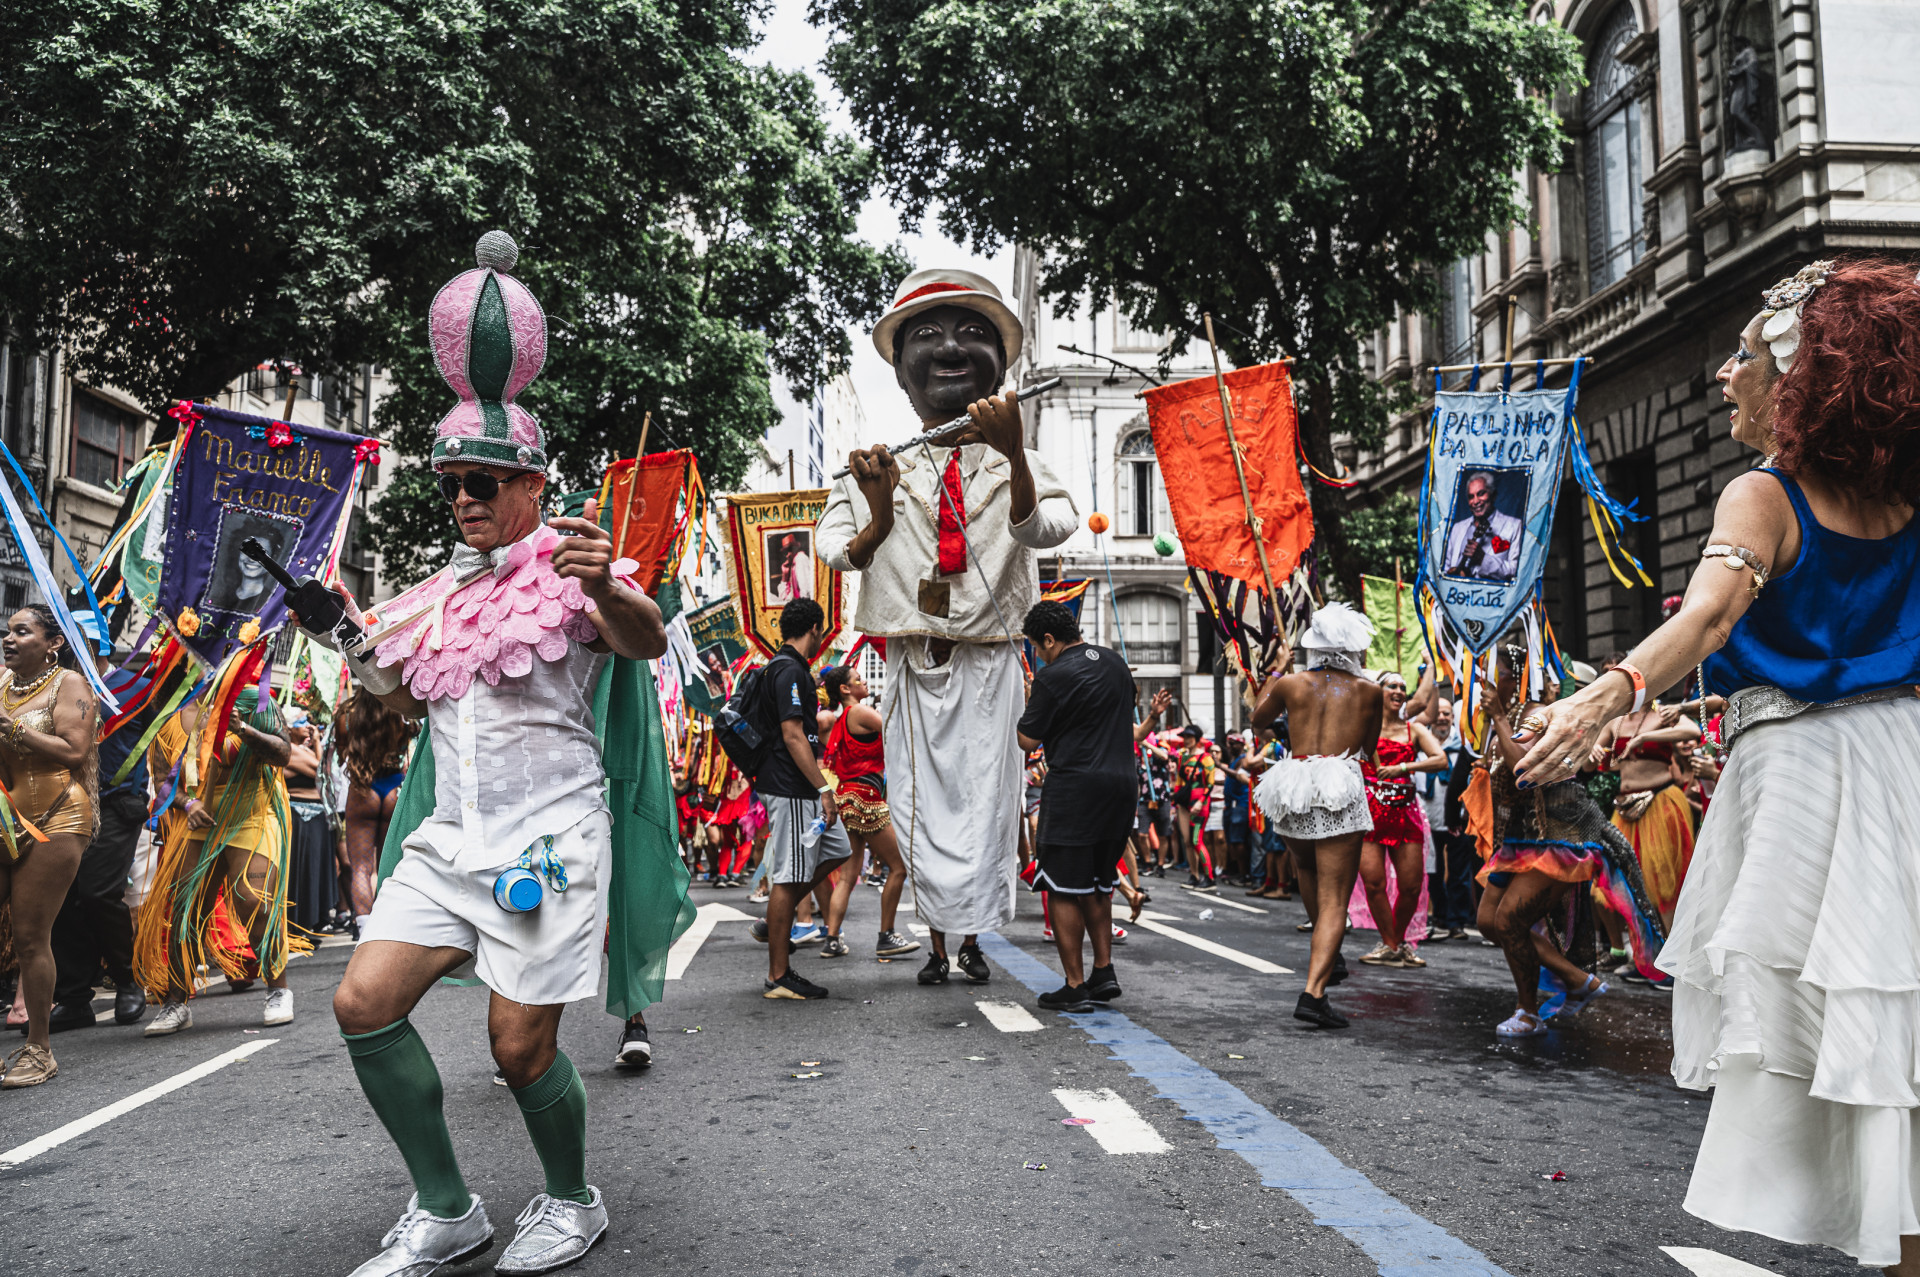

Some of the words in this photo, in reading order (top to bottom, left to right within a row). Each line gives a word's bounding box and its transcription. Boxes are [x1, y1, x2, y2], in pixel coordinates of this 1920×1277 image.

[200, 429, 340, 494] Marielle
[1439, 437, 1466, 459] DA
[1482, 438, 1549, 464] VIOLA
[212, 471, 316, 518] Franco
[745, 505, 782, 525] BUKA
